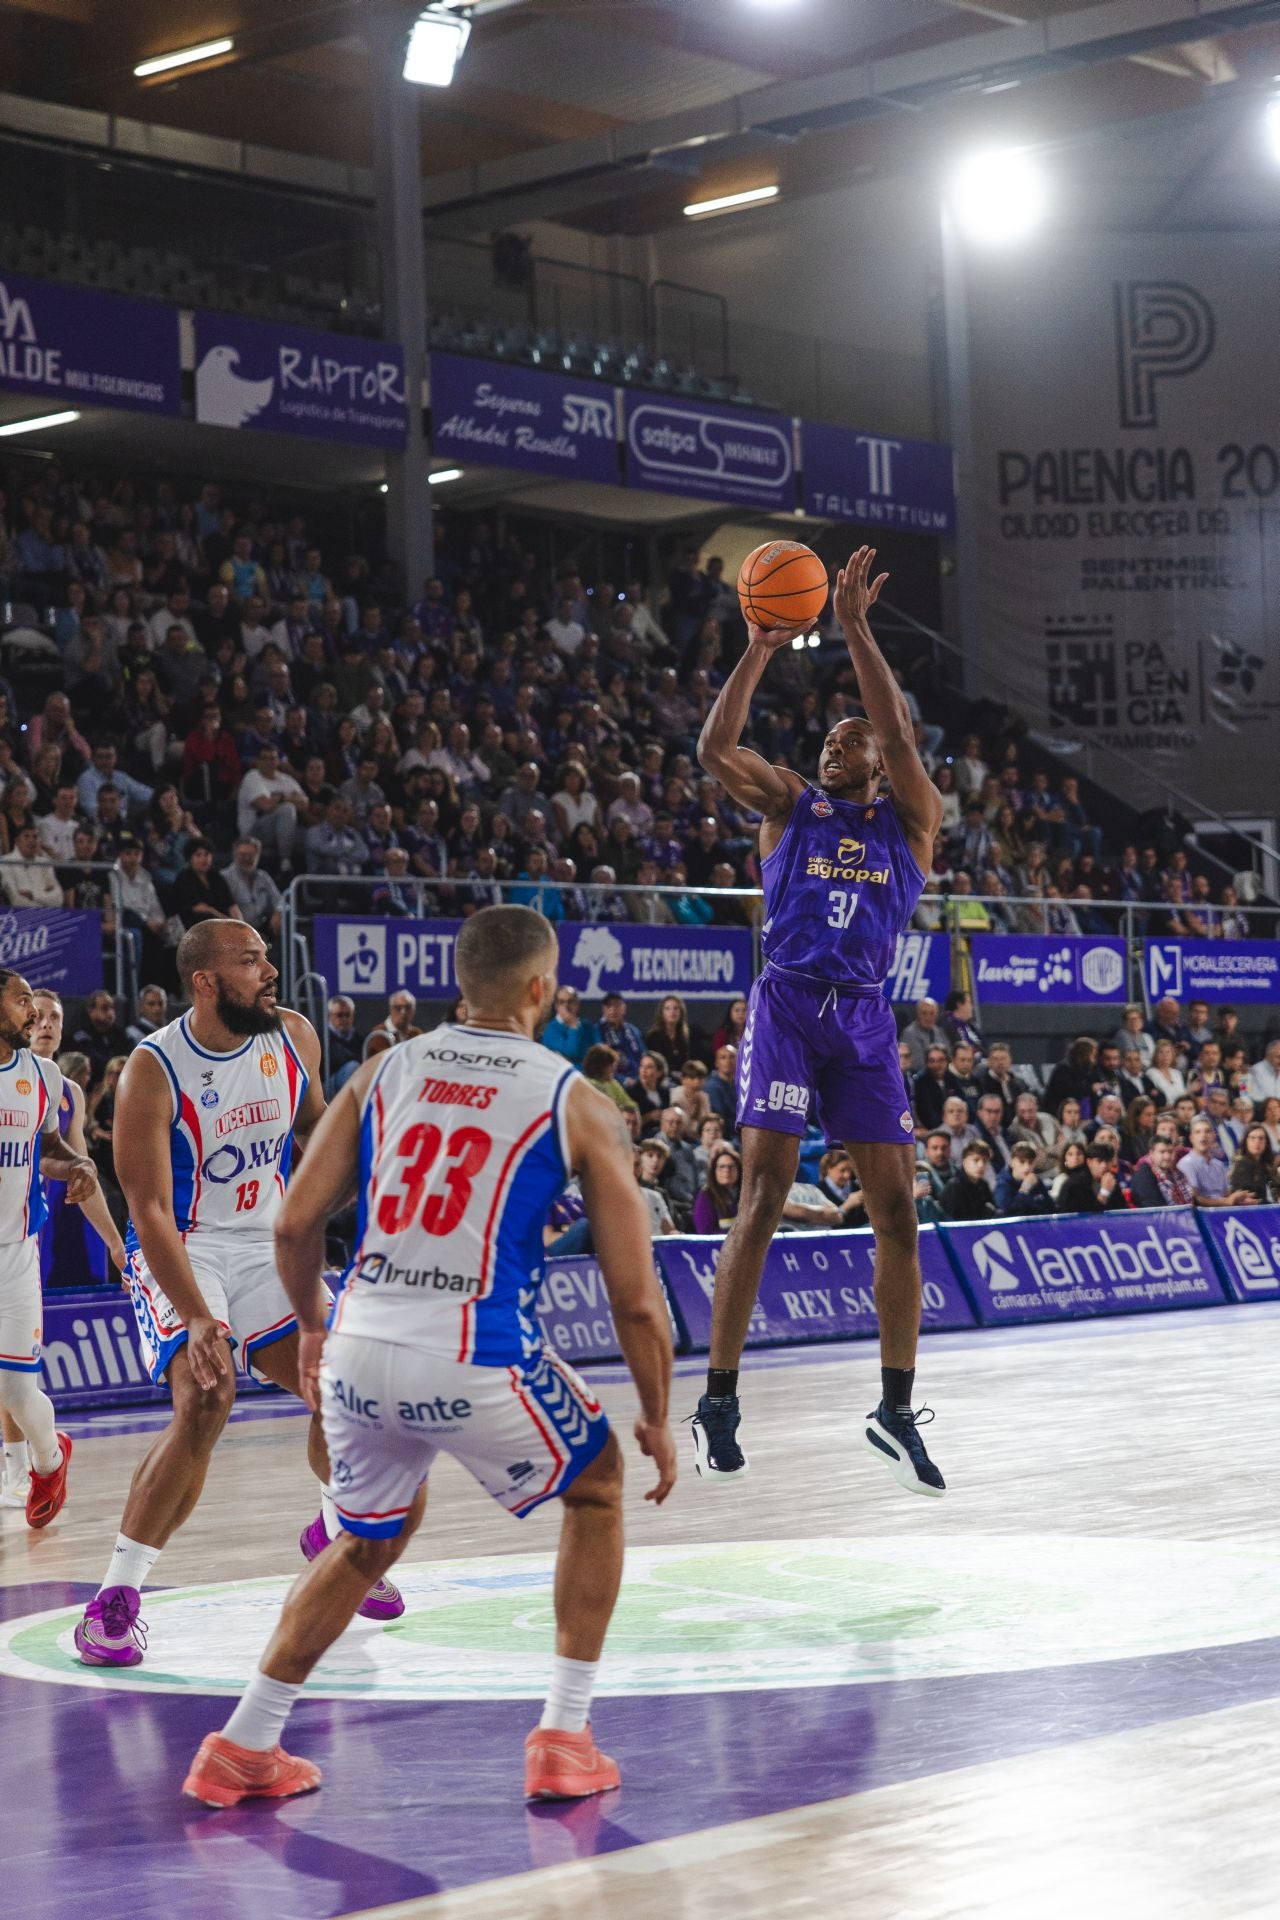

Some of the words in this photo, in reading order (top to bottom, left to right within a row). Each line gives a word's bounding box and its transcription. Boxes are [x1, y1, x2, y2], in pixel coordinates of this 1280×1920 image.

[279, 345, 407, 405] RAPTOR
[999, 446, 1196, 507] PALENCIA
[1126, 670, 1190, 697] LEN
[1126, 699, 1183, 726] CIA
[806, 863, 890, 885] agropal
[827, 890, 859, 929] 31
[397, 933, 460, 987] PET
[631, 947, 735, 983] TECNICAMPO
[417, 1077, 497, 1111] TORRES
[215, 1098, 281, 1139] LUCENTUM
[0, 1141, 30, 1168] HLA
[247, 1132, 286, 1170] HLA
[235, 1179, 260, 1212] 13
[377, 1122, 493, 1237] 33
[782, 1247, 877, 1272] HOT
[1016, 1226, 1202, 1288] lambda
[781, 1288, 836, 1320] REY
[840, 1282, 945, 1315] SAO
[37, 1316, 146, 1389] mili
